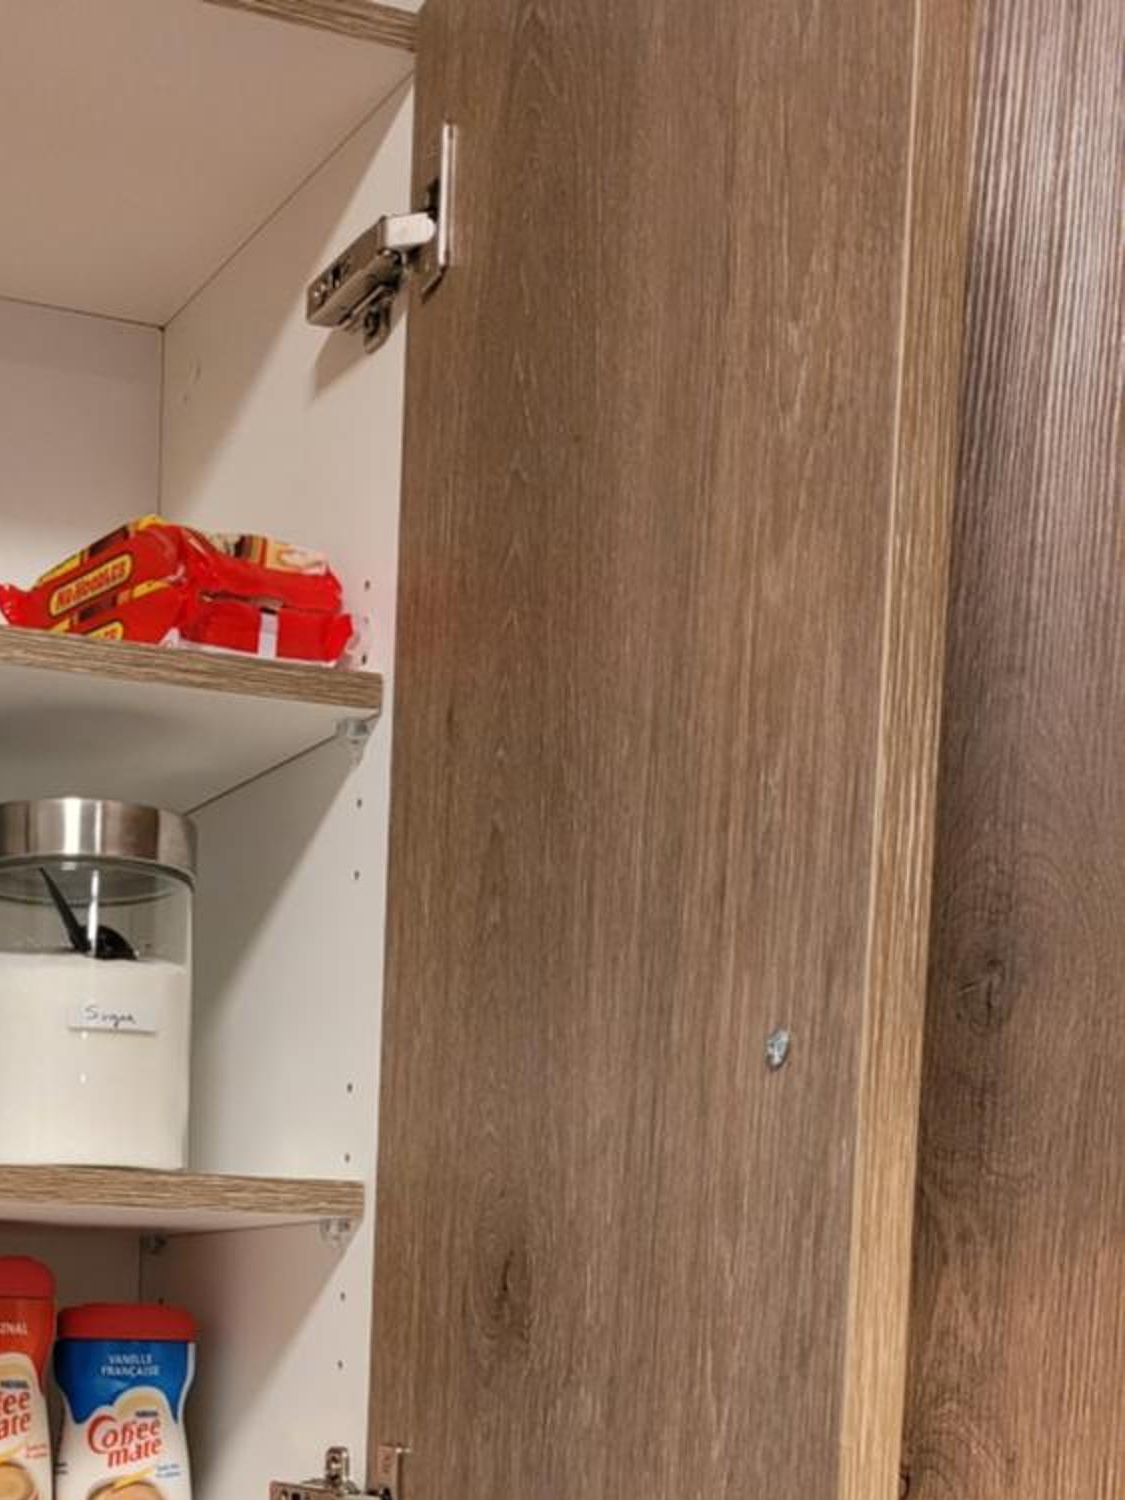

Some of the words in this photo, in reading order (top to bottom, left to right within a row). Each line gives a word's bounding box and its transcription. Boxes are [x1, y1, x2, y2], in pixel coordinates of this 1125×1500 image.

[108, 1354, 152, 1364] VANILLE
[101, 1366, 160, 1377] FRANÇAISE
[88, 1414, 162, 1454] Coffee
[108, 1439, 163, 1468] mate
